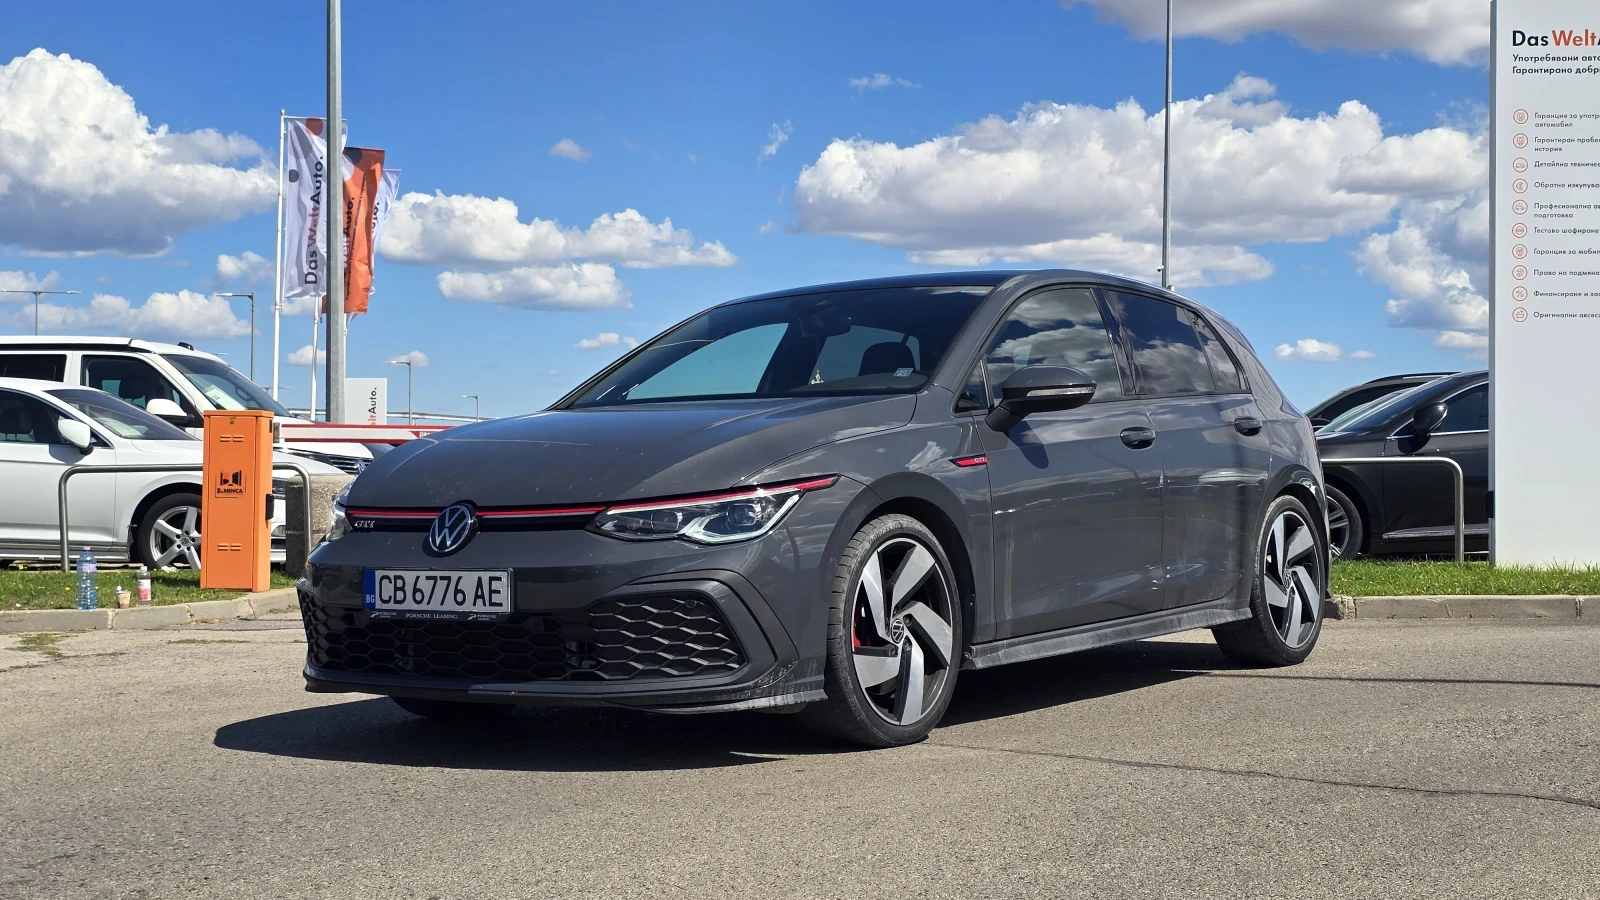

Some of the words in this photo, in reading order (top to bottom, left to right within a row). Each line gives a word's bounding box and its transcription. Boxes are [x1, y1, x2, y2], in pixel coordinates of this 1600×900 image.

[1512, 30, 1549, 47] Das
[1551, 29, 1600, 47] Welt
[1512, 53, 1579, 63] Употребявани
[1512, 65, 1573, 75] Гарантирано
[1575, 64, 1600, 75] добр
[1534, 112, 1568, 120] Гаранция
[1534, 136, 1575, 144] Гарантиран
[1533, 160, 1568, 168] Детайлно
[1533, 181, 1566, 189] Обратно
[307, 155, 324, 248] WeltAuto.
[1533, 202, 1592, 210] Професионална
[1533, 226, 1560, 234] Тестово
[1561, 227, 1599, 235] шофиране
[1533, 247, 1567, 256] Гаранция
[304, 247, 318, 285] Das
[1533, 269, 1556, 277] Право
[1533, 290, 1582, 298] Финансиране
[1533, 311, 1577, 319] Оригинални
[354, 520, 376, 529] GTI
[379, 574, 407, 605] CB
[412, 575, 467, 607] 6776
[472, 576, 503, 608] AE
[365, 594, 375, 604] BG
